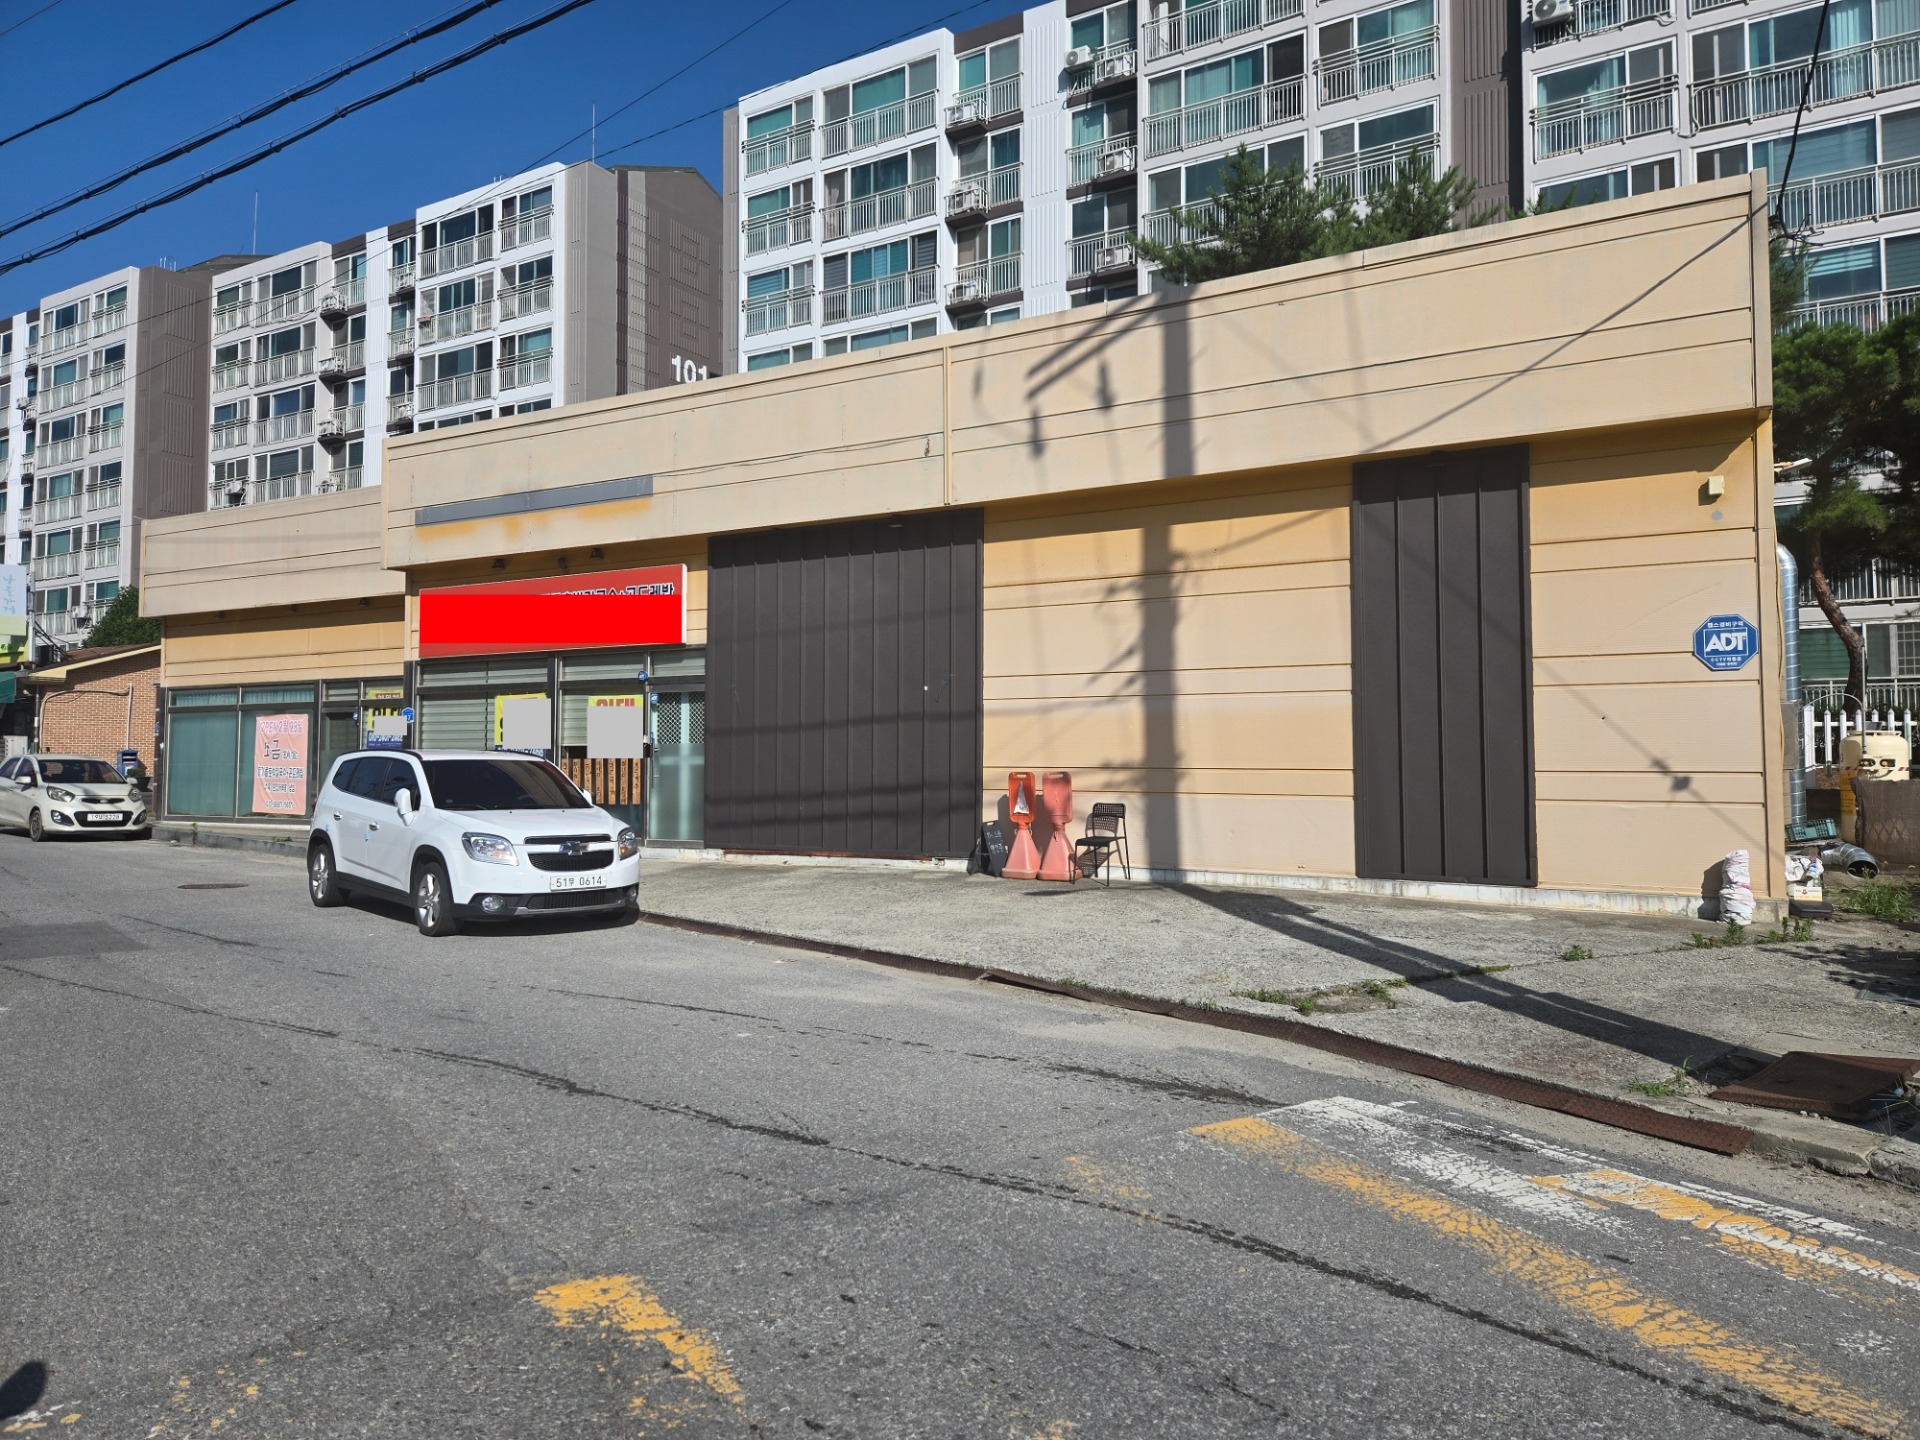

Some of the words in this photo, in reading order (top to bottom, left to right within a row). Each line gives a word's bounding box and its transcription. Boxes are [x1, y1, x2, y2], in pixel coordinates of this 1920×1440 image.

[671, 354, 707, 384] 101
[1705, 632, 1746, 652] ADT
[260, 721, 277, 733] OPEN
[579, 875, 602, 886] 0614
